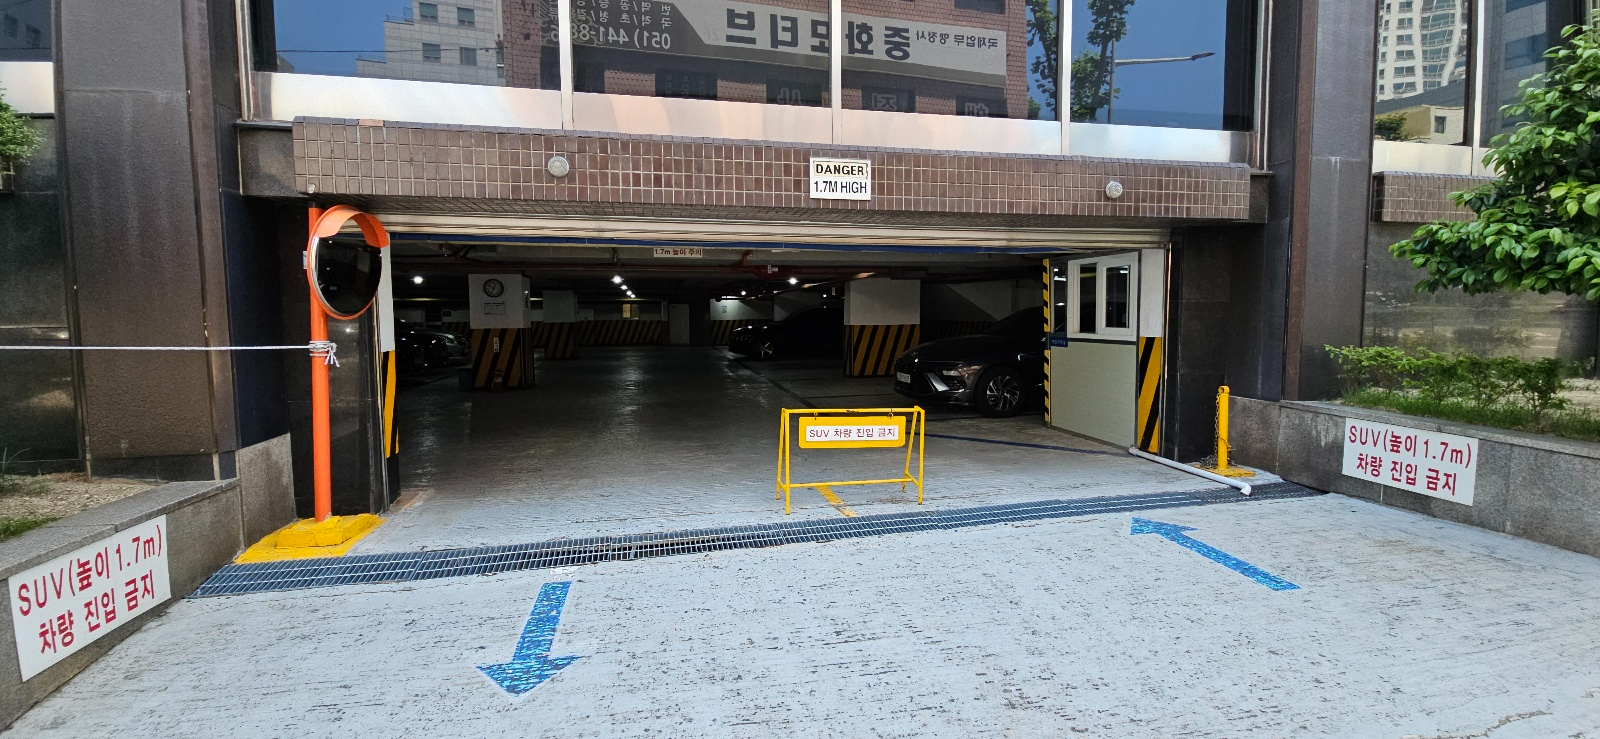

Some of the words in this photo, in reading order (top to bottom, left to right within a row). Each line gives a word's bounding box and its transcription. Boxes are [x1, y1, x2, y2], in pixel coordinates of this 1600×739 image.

[816, 163, 864, 176] DANGER
[814, 180, 838, 193] 1.7M
[840, 181, 867, 194] HIGH
[672, 248, 686, 256] 높이
[809, 429, 830, 438] SUV
[833, 428, 853, 438] 차량
[856, 427, 874, 438] 진입
[877, 427, 896, 437] 금지
[1356, 452, 1383, 478] 차량
[1390, 460, 1418, 487] 진입
[1425, 467, 1457, 496] 금지
[38, 609, 75, 654] 차량
[83, 587, 117, 633] 진입
[124, 569, 155, 612] 금지
